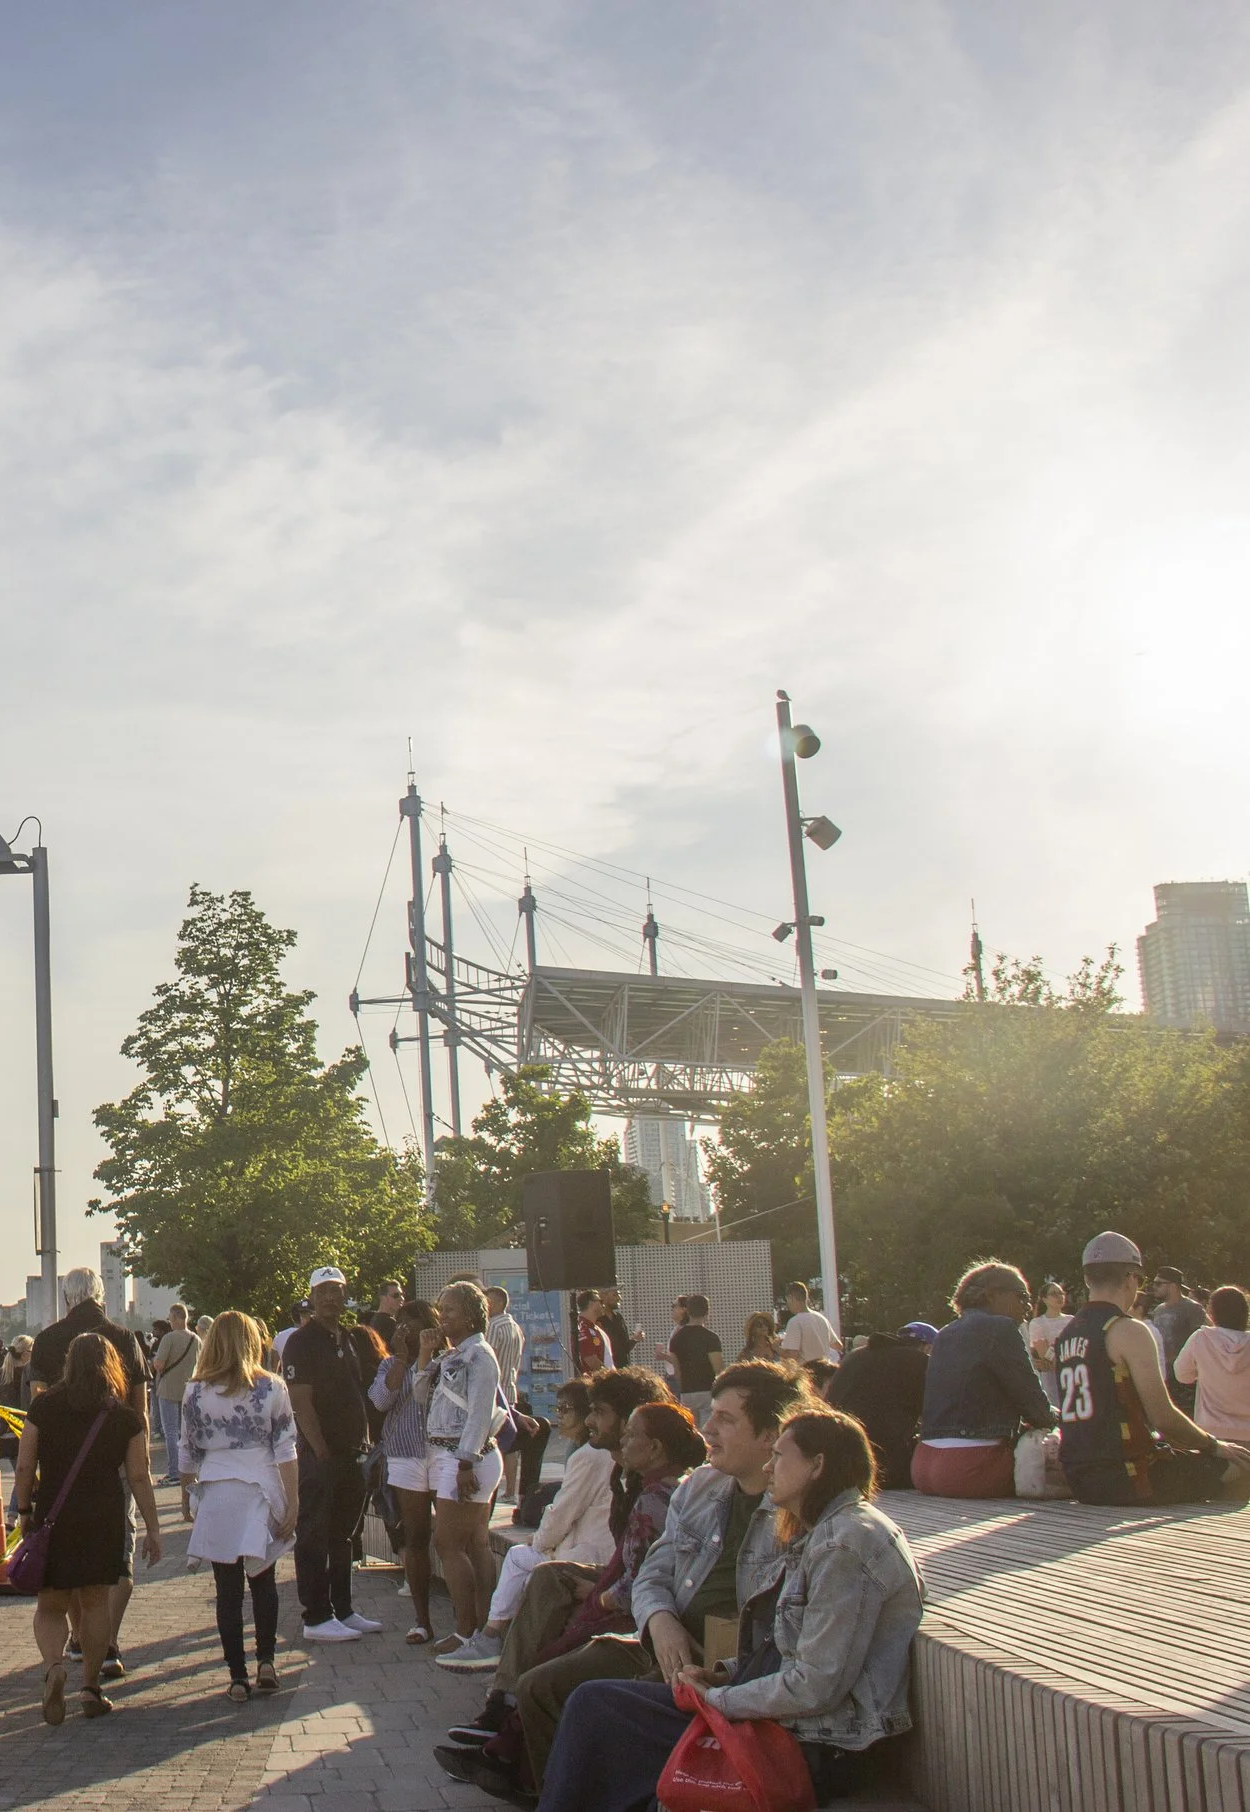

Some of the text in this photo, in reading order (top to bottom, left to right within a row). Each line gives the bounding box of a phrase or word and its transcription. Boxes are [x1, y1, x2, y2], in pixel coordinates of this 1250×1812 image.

[520, 1311, 555, 1320] Tickets
[1059, 1336, 1089, 1362] JAMES
[1060, 1363, 1094, 1422] 23
